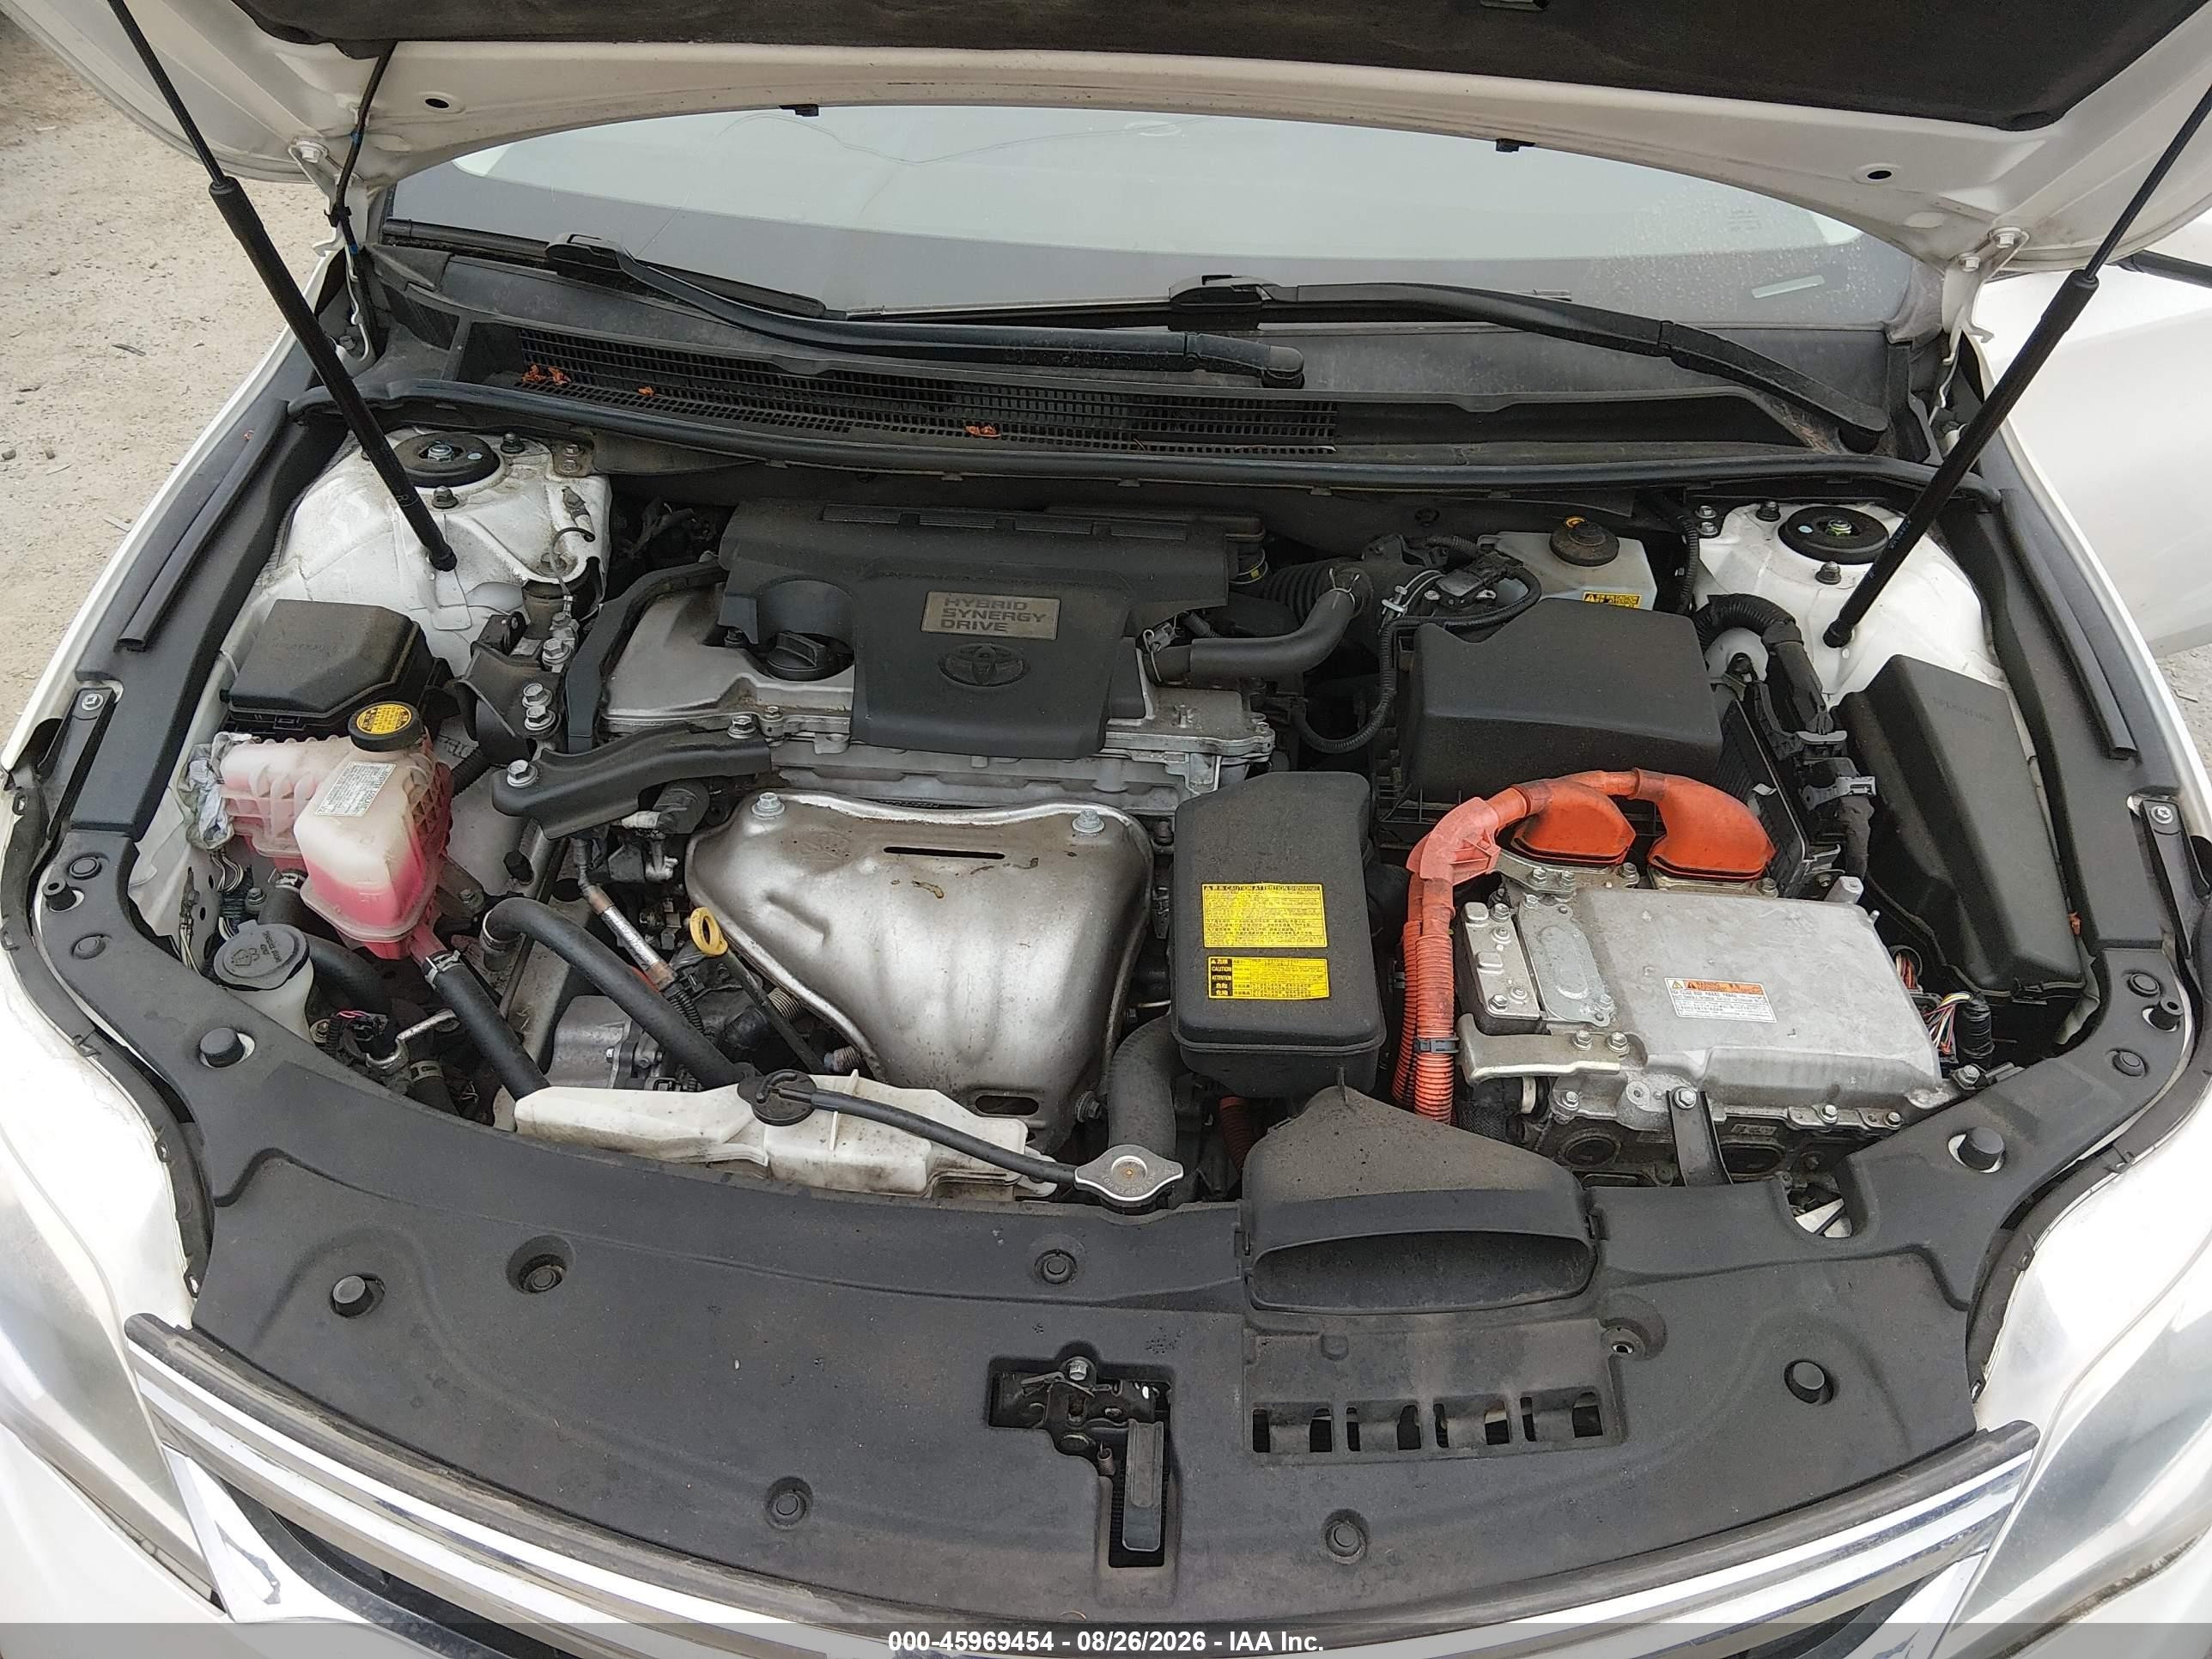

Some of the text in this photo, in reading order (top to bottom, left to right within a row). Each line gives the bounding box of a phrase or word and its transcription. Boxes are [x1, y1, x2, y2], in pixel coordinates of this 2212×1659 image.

[945, 598, 1028, 611] HYBRID
[942, 608, 1047, 623] SYNERGY
[941, 618, 1009, 633] DRIVE
